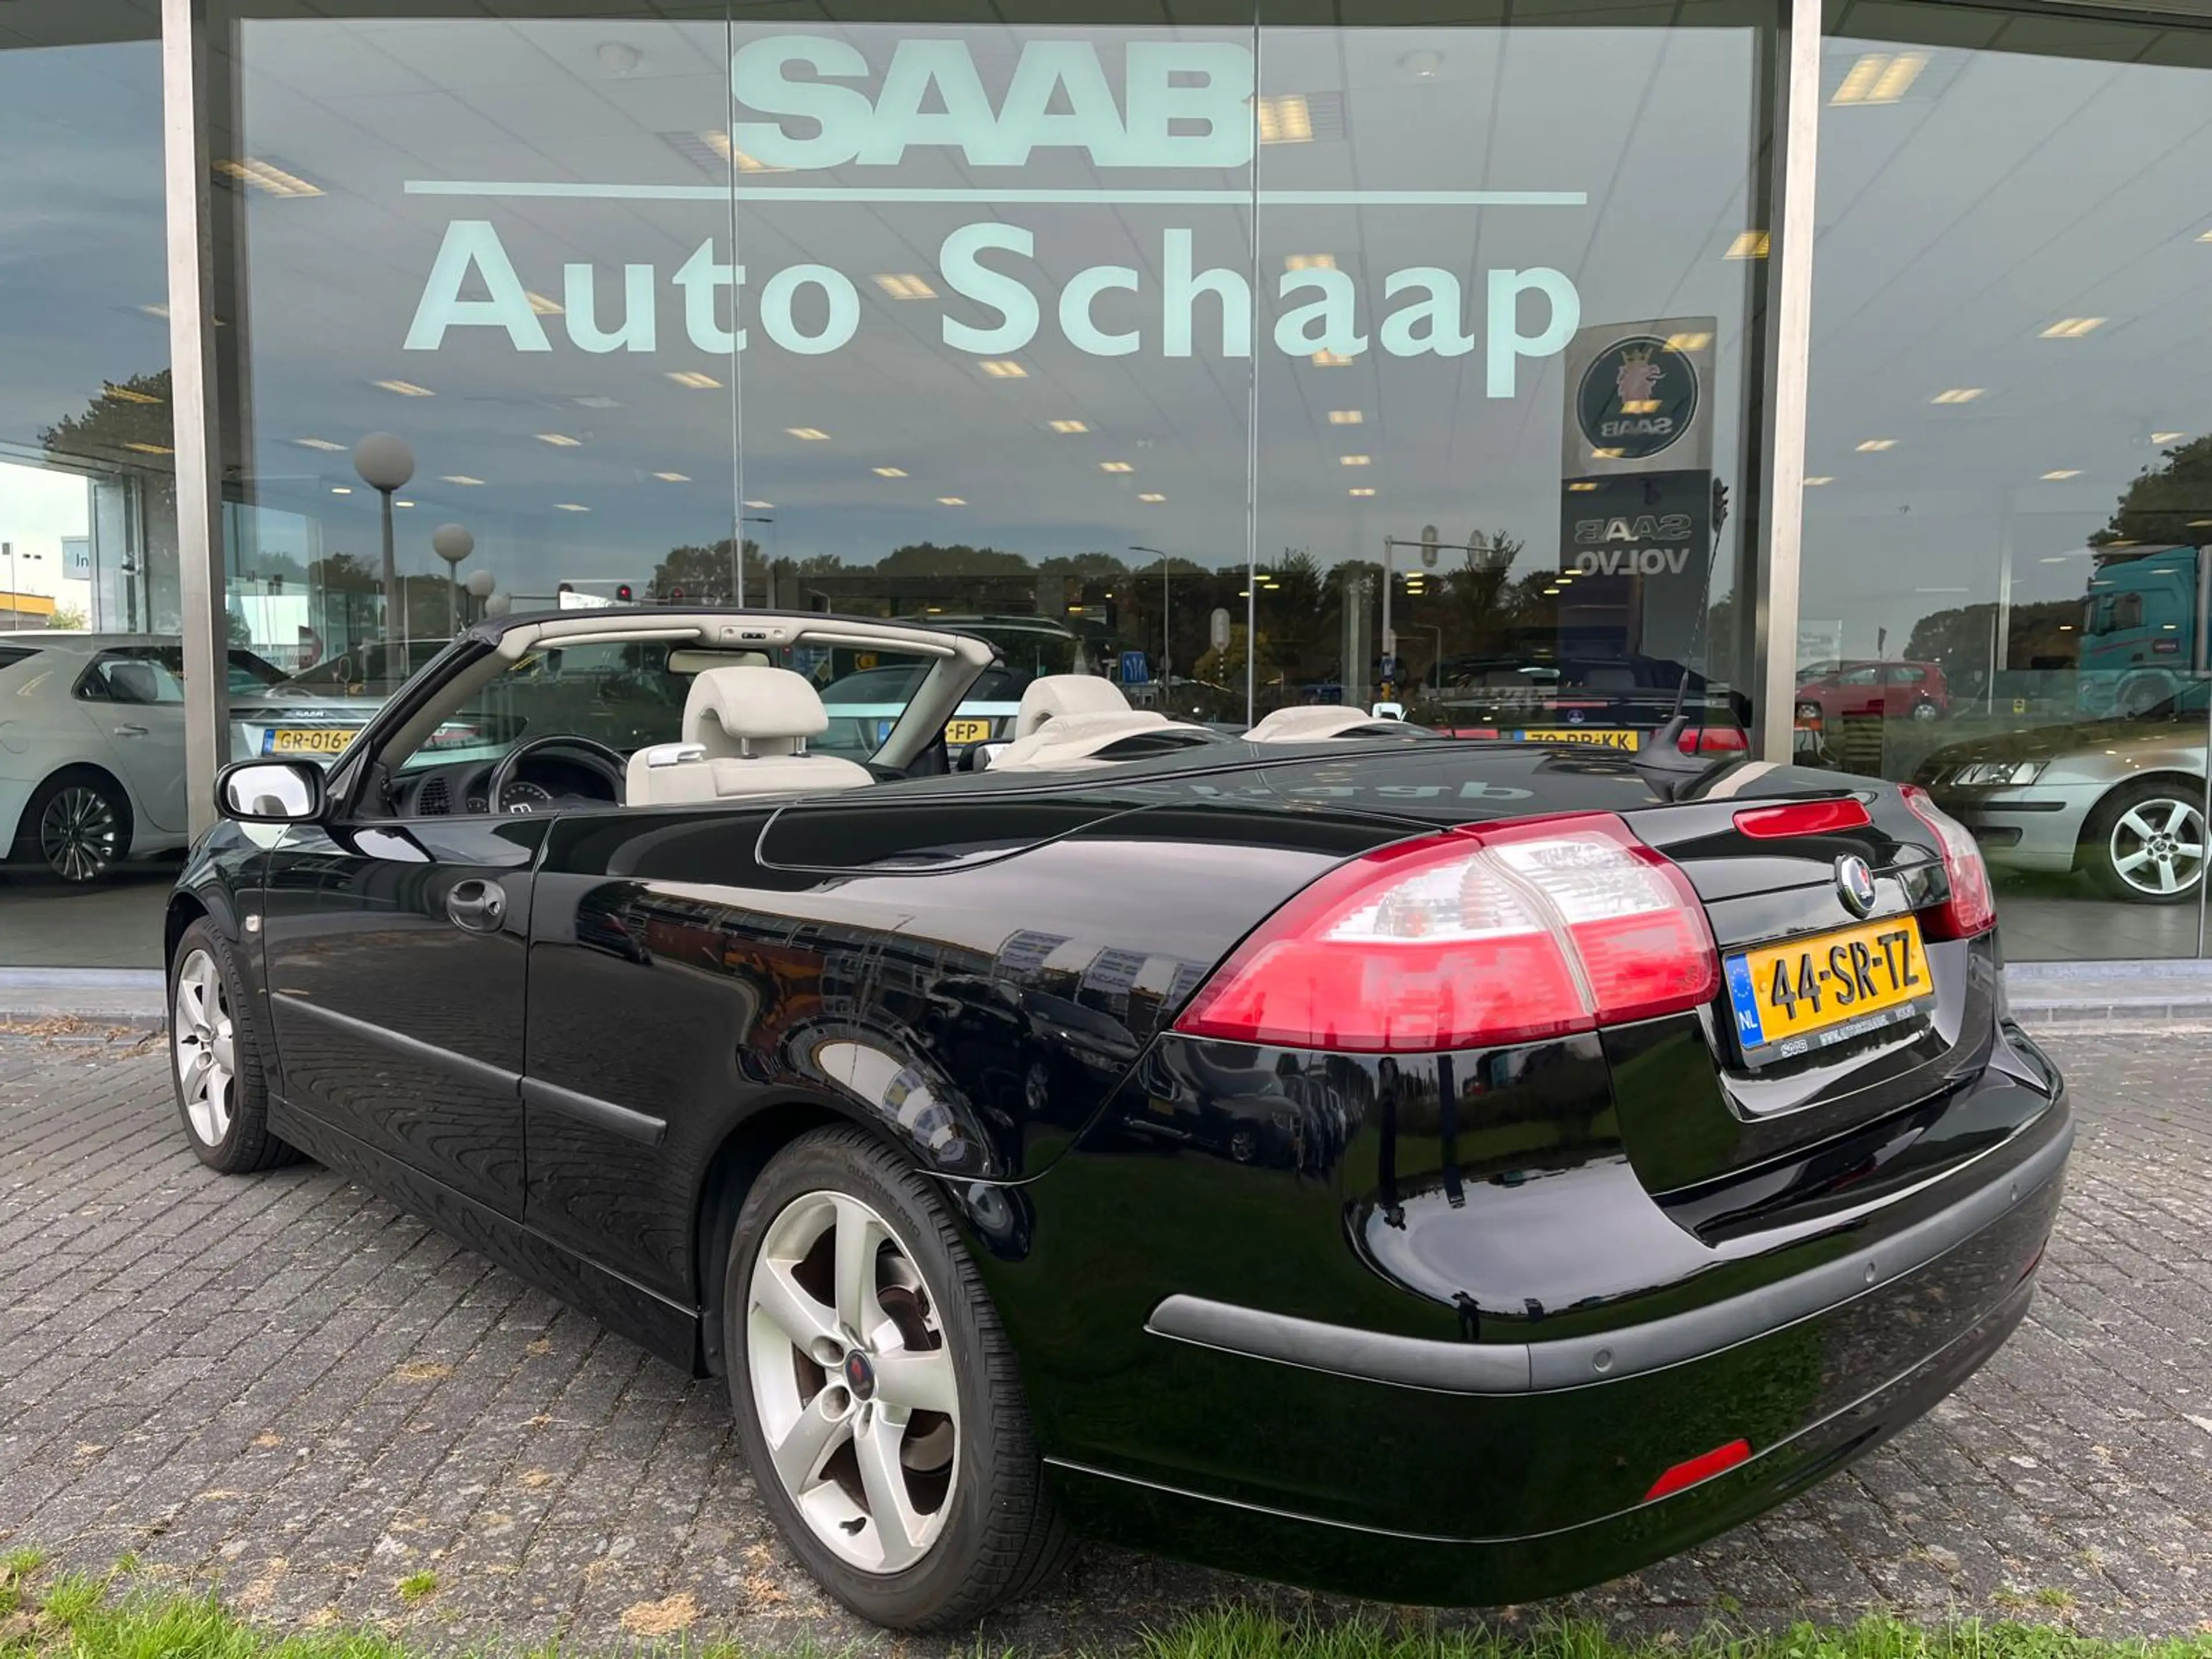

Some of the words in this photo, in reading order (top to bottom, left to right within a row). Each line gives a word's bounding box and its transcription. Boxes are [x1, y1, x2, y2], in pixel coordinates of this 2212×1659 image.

[733, 36, 1255, 169] SAAB
[404, 220, 859, 354] Auto
[941, 222, 1581, 399] Schaap
[1738, 1009, 1759, 1032] NL
[1771, 930, 1920, 1020] 44-SR-TZ
